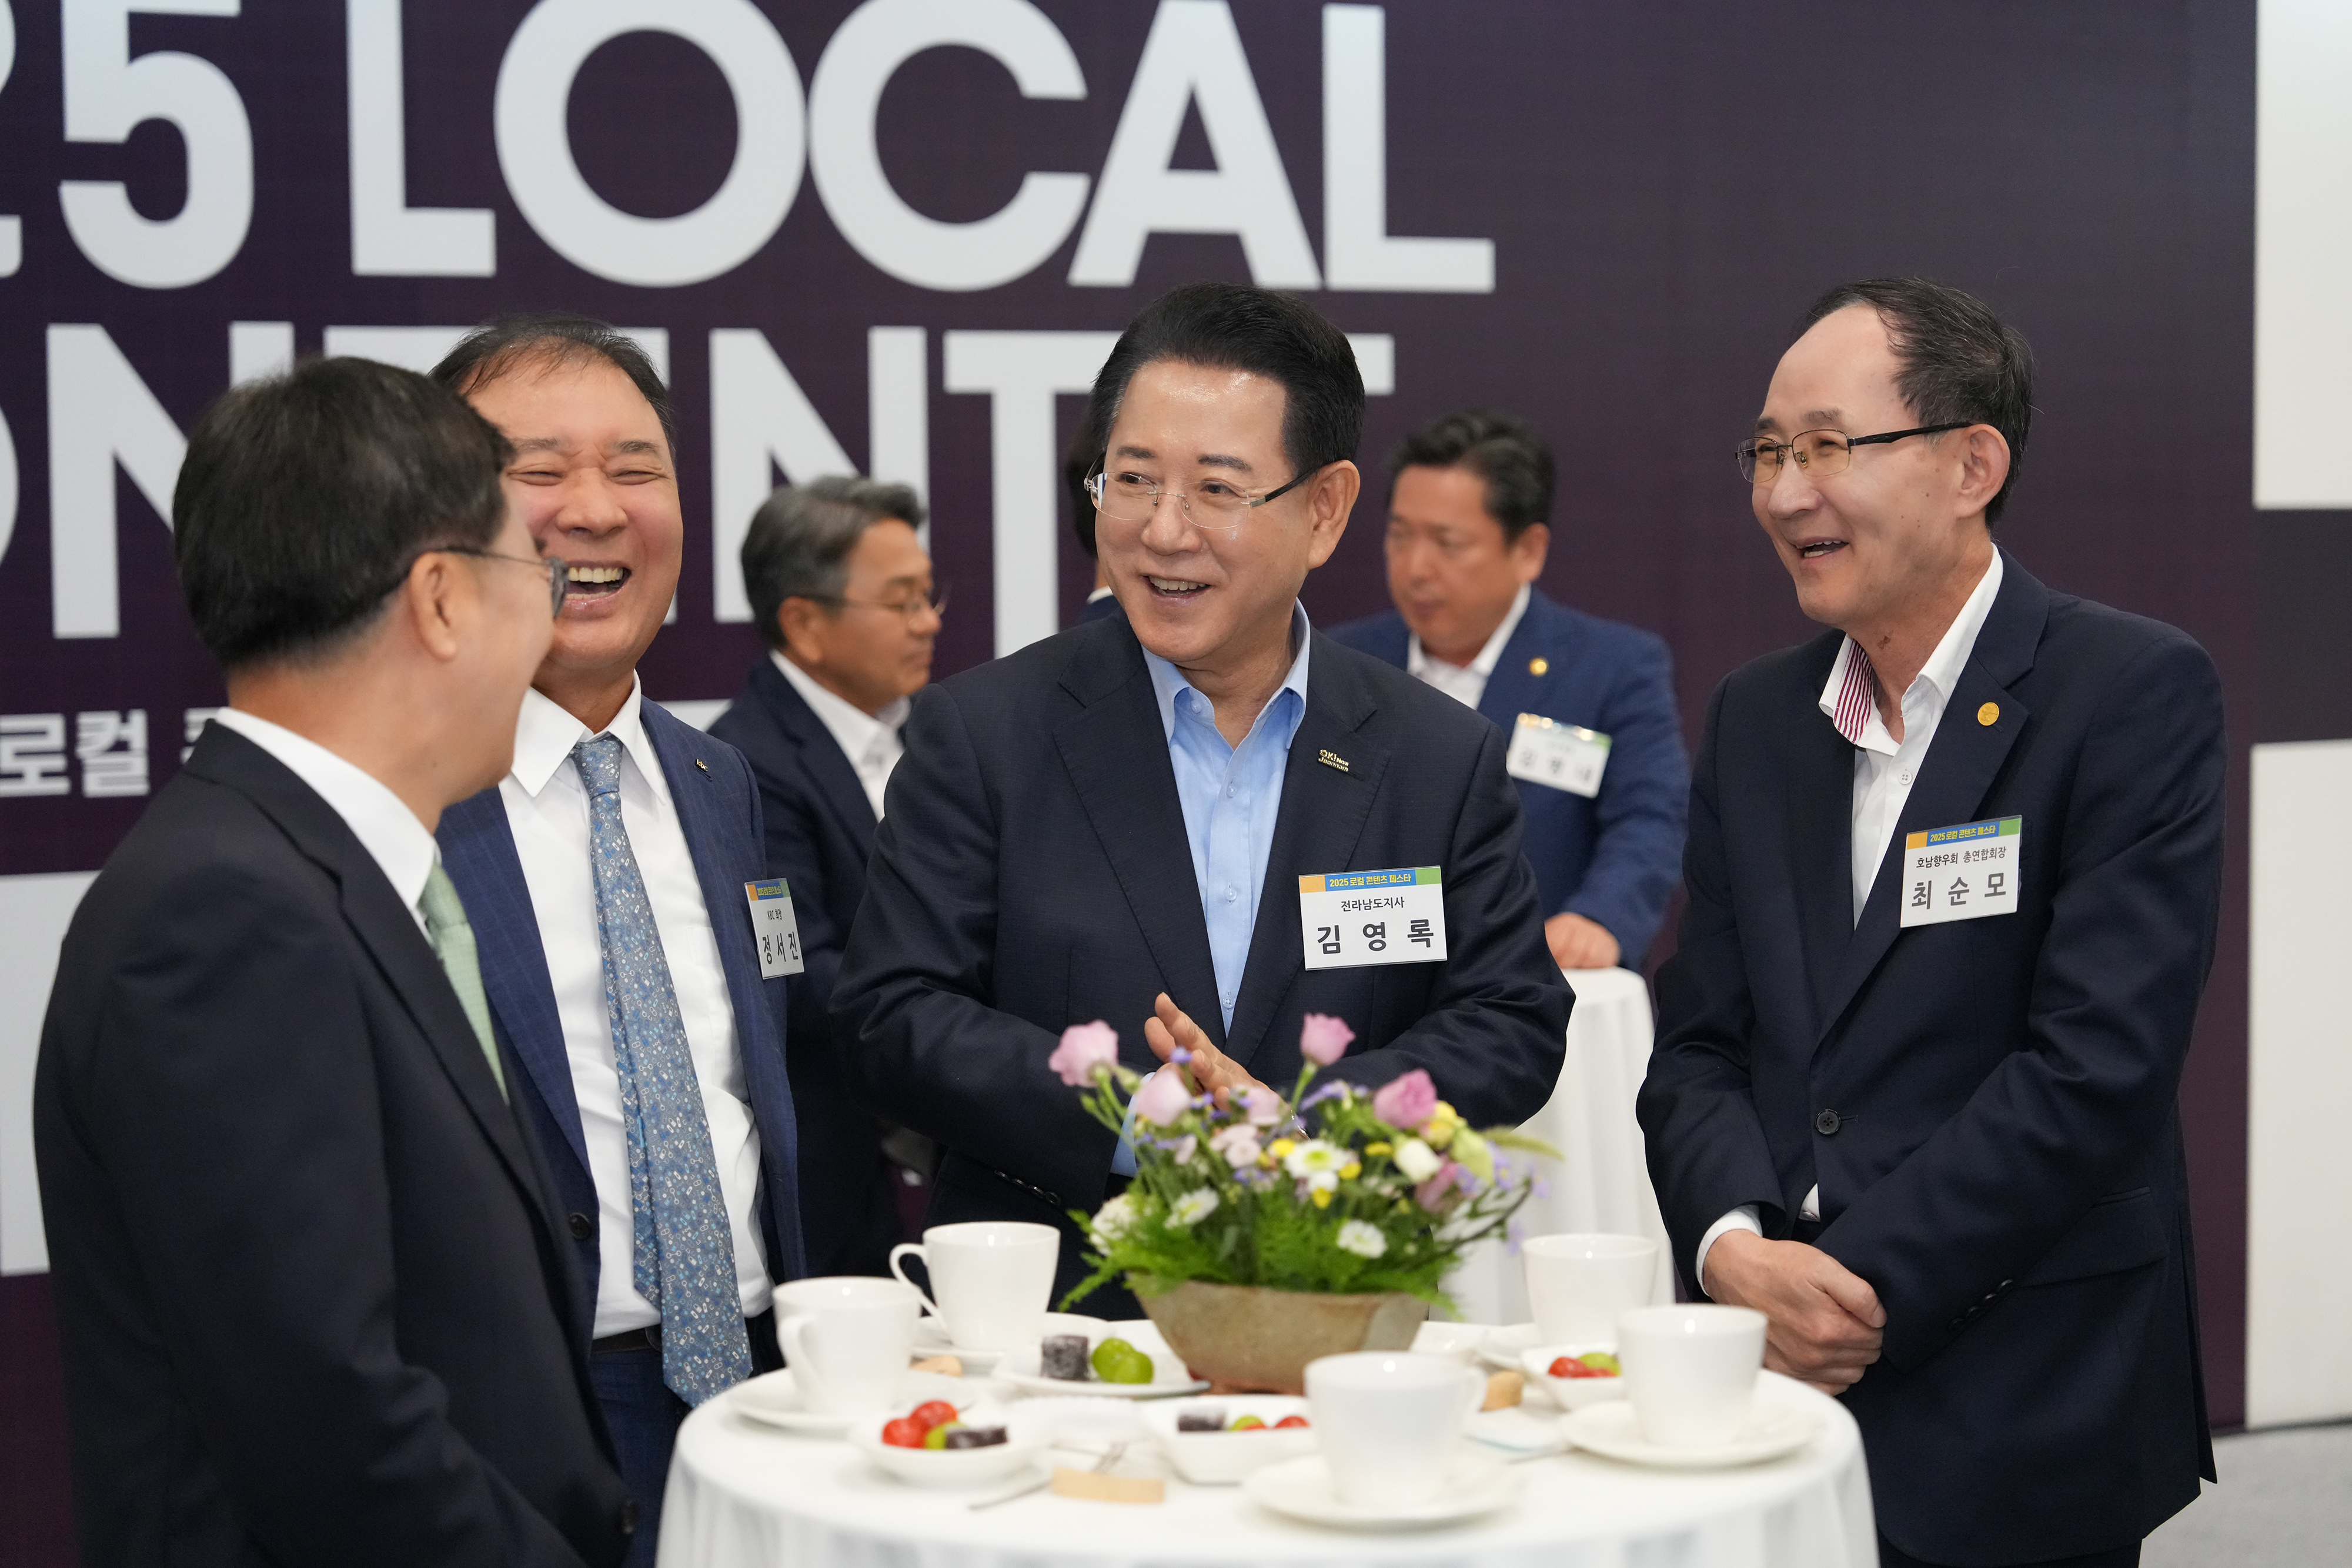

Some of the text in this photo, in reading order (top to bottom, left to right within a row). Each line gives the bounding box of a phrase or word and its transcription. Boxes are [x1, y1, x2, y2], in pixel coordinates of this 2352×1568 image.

[346, 0, 1495, 293] LOCAL
[0, 709, 149, 798] 로컬
[1930, 825, 1996, 842] 2025 로컬 콘텐츠 페스타
[1916, 846, 2007, 868] 호남향우회 총연합회장
[1329, 873, 1412, 888] 2025 로컬 콘텐츠 페스타
[1341, 897, 1405, 912] 전라남도지사
